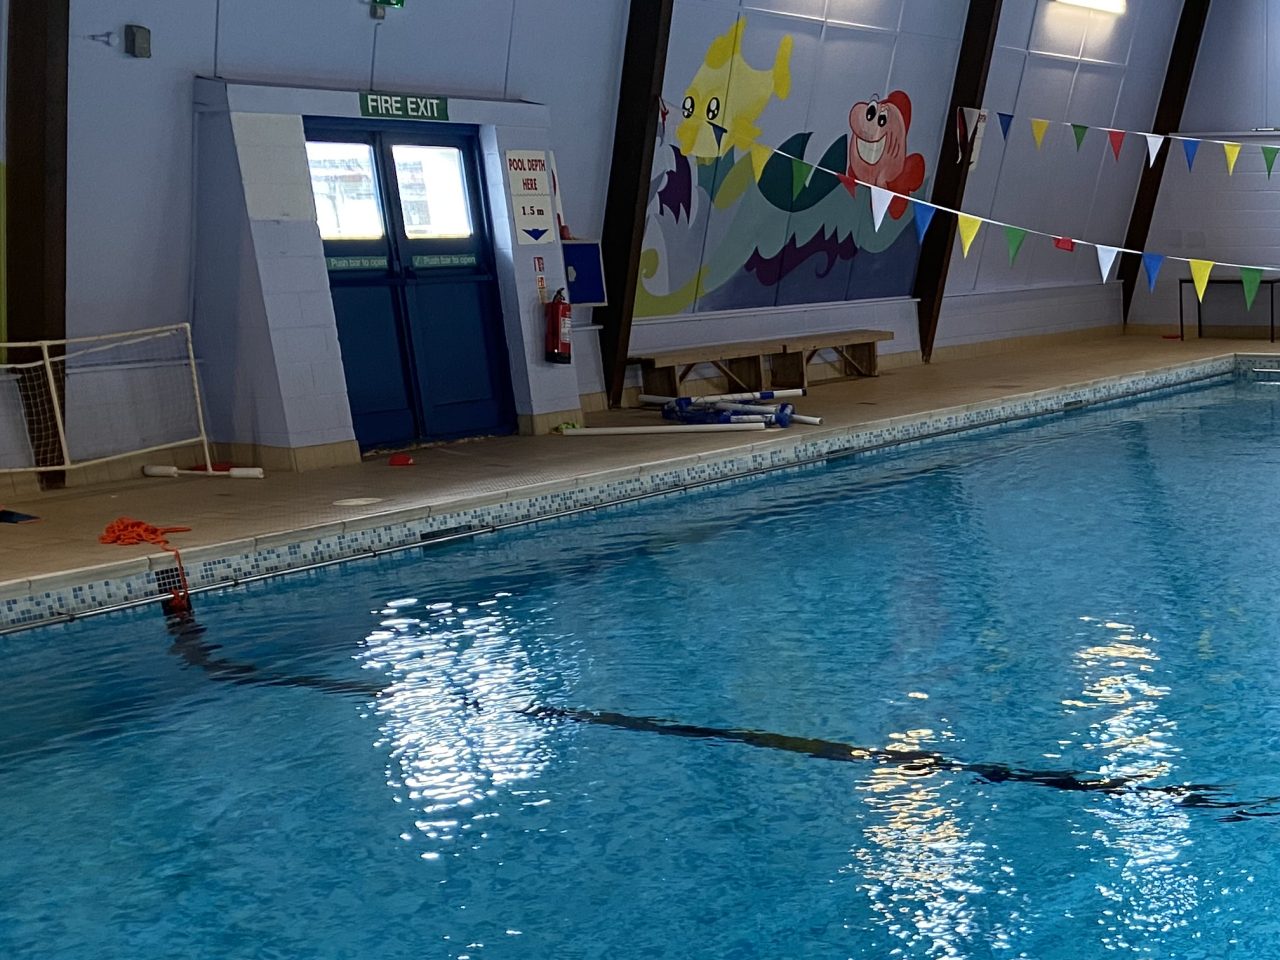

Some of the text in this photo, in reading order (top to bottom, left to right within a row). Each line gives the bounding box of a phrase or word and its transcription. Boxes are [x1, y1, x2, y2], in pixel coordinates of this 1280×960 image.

[367, 95, 440, 117] FIRE EXIT
[508, 158, 546, 171] POOL DEPTH
[522, 178, 538, 191] HERE
[521, 206, 544, 216] 1.5 m
[330, 258, 387, 268] Push bar to open
[423, 256, 476, 265] Push bar to open
